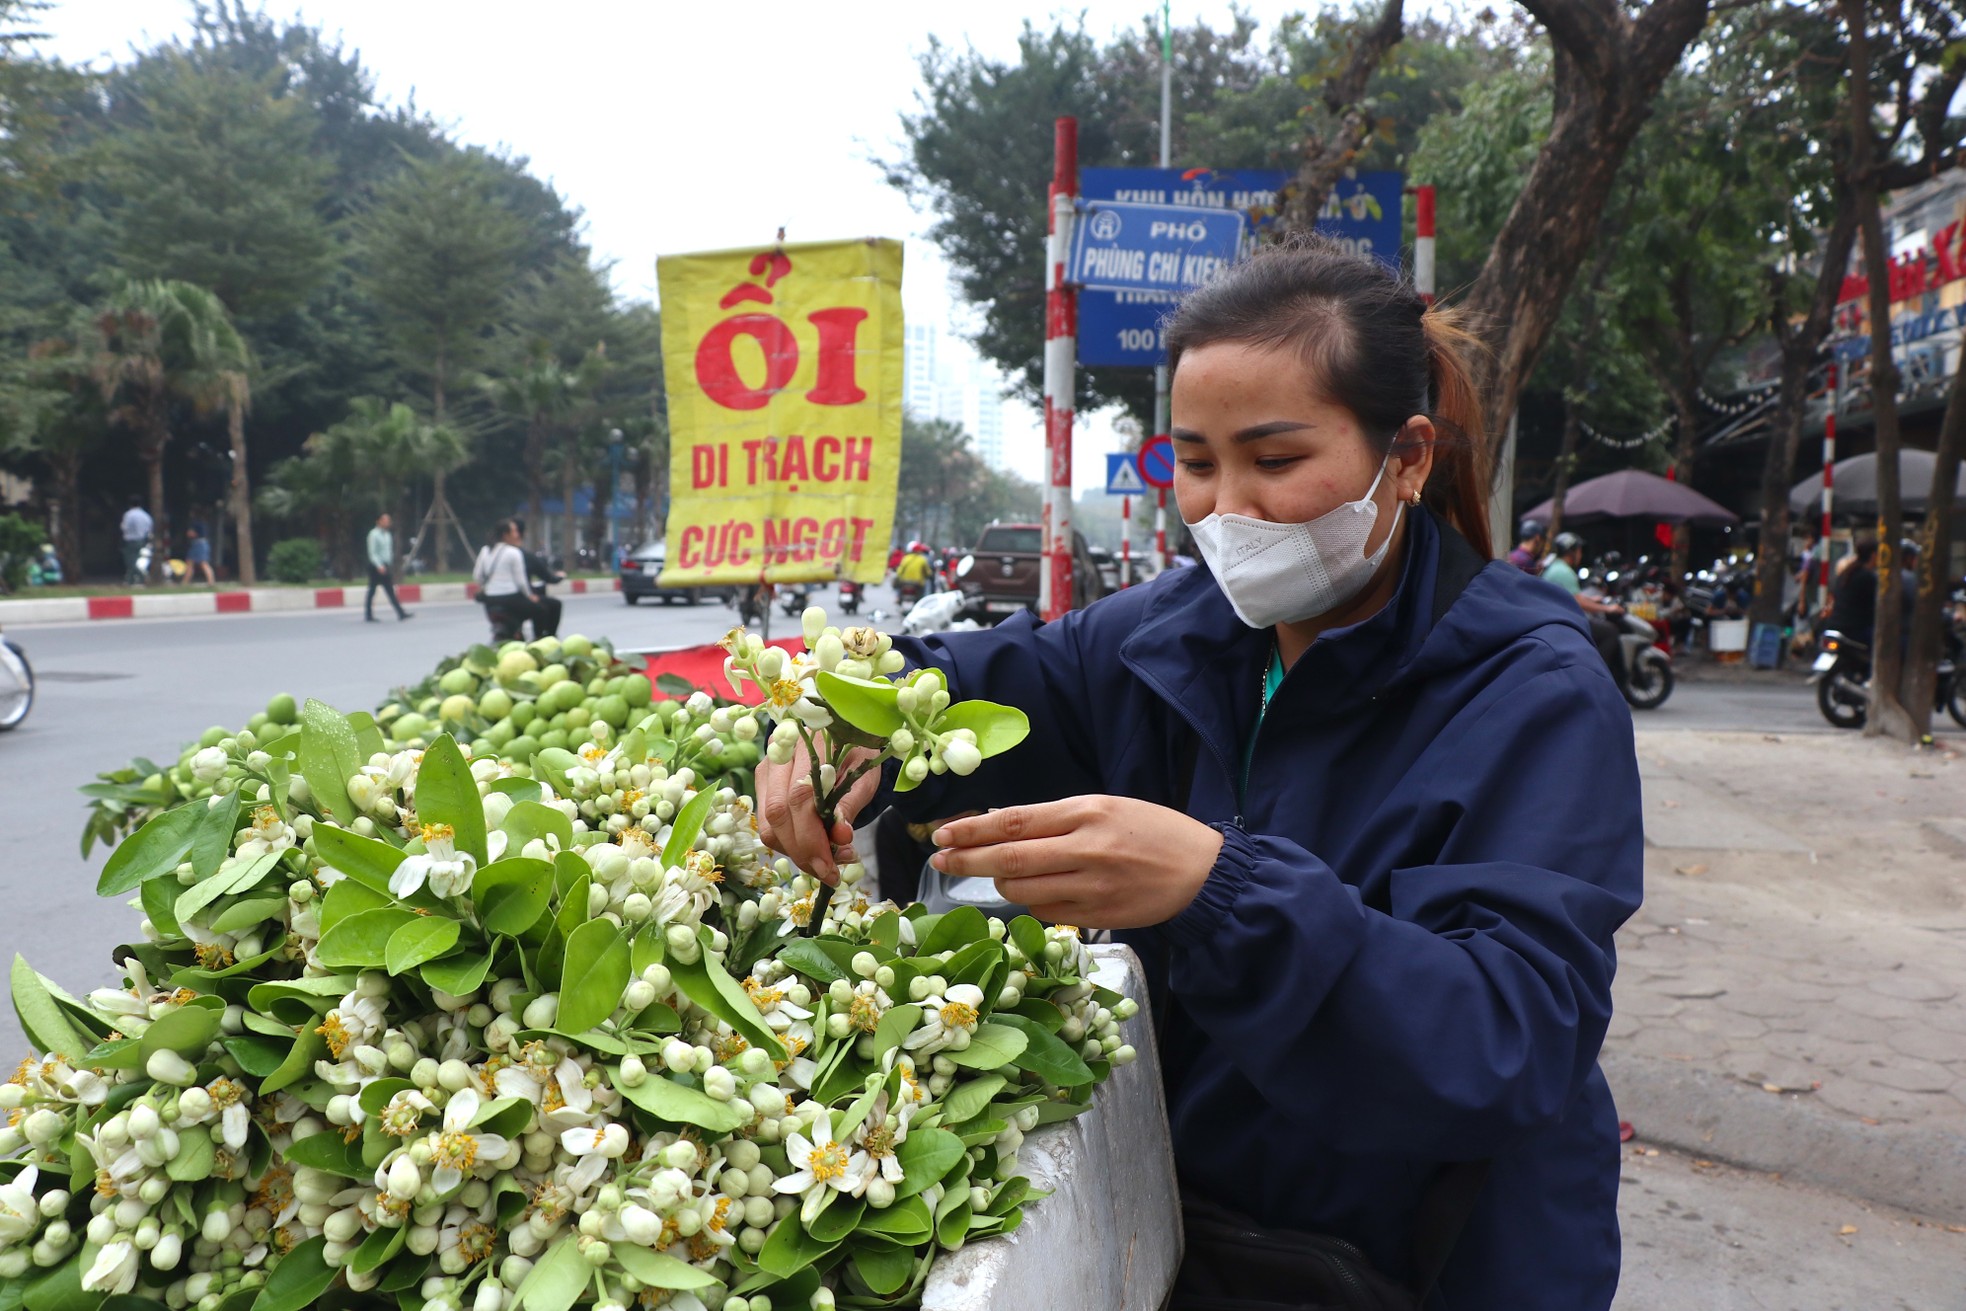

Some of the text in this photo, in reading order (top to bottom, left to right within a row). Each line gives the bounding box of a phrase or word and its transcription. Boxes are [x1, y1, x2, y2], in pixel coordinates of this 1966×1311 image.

[1150, 216, 1208, 241] PHỐ
[1082, 242, 1145, 281] PHÙNG
[1147, 248, 1182, 283] CHÍ
[694, 251, 869, 410] ỔI
[1117, 328, 1155, 351] 100
[692, 435, 873, 492] DI TRẠCH
[679, 516, 875, 576] CỰC NGỌT
[1235, 536, 1263, 557] ITALY
